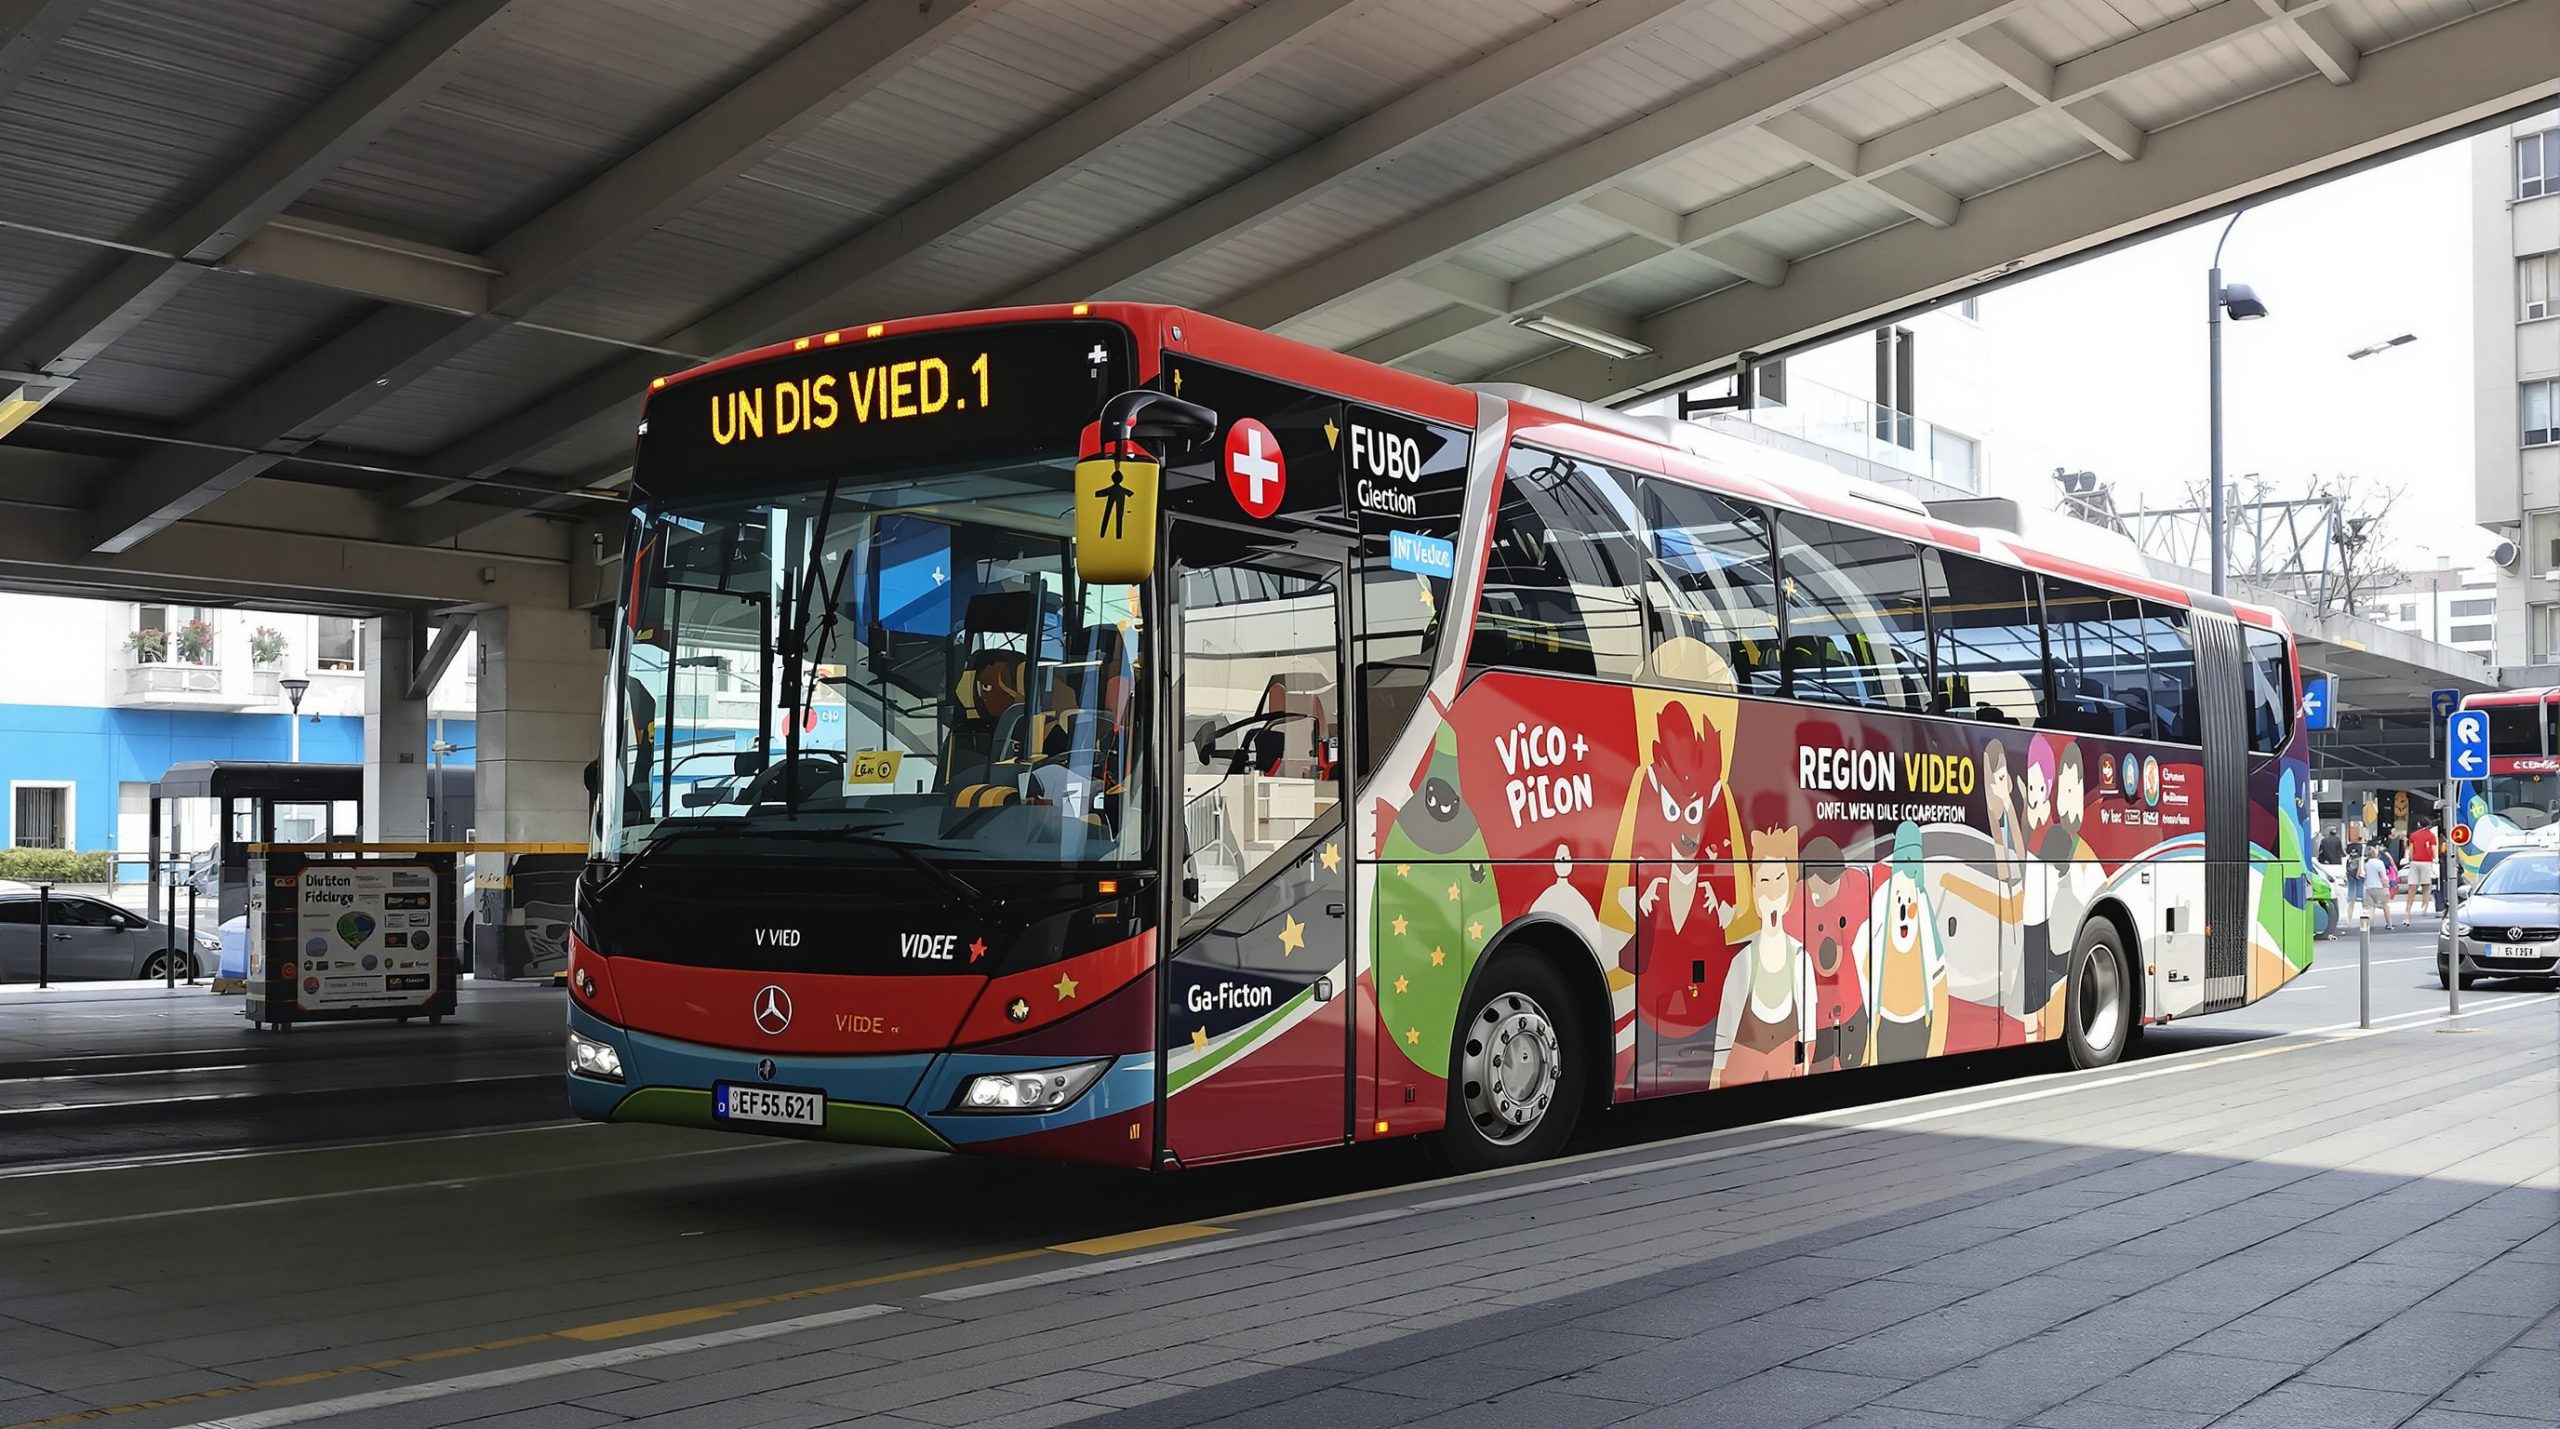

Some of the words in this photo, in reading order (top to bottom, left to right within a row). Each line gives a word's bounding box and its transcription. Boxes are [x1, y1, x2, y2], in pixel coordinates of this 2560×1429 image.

[712, 387, 763, 445] UN
[775, 374, 838, 435] DIS
[1351, 424, 1420, 483] FUBO
[2457, 717, 2481, 745] R
[1799, 746, 1896, 793] REGION
[1903, 752, 1975, 795] VIDEO
[755, 928, 766, 946] V
[769, 929, 801, 947] VIED
[901, 933, 957, 960] VIDEE
[1187, 982, 1272, 1013] Ga-Ficton
